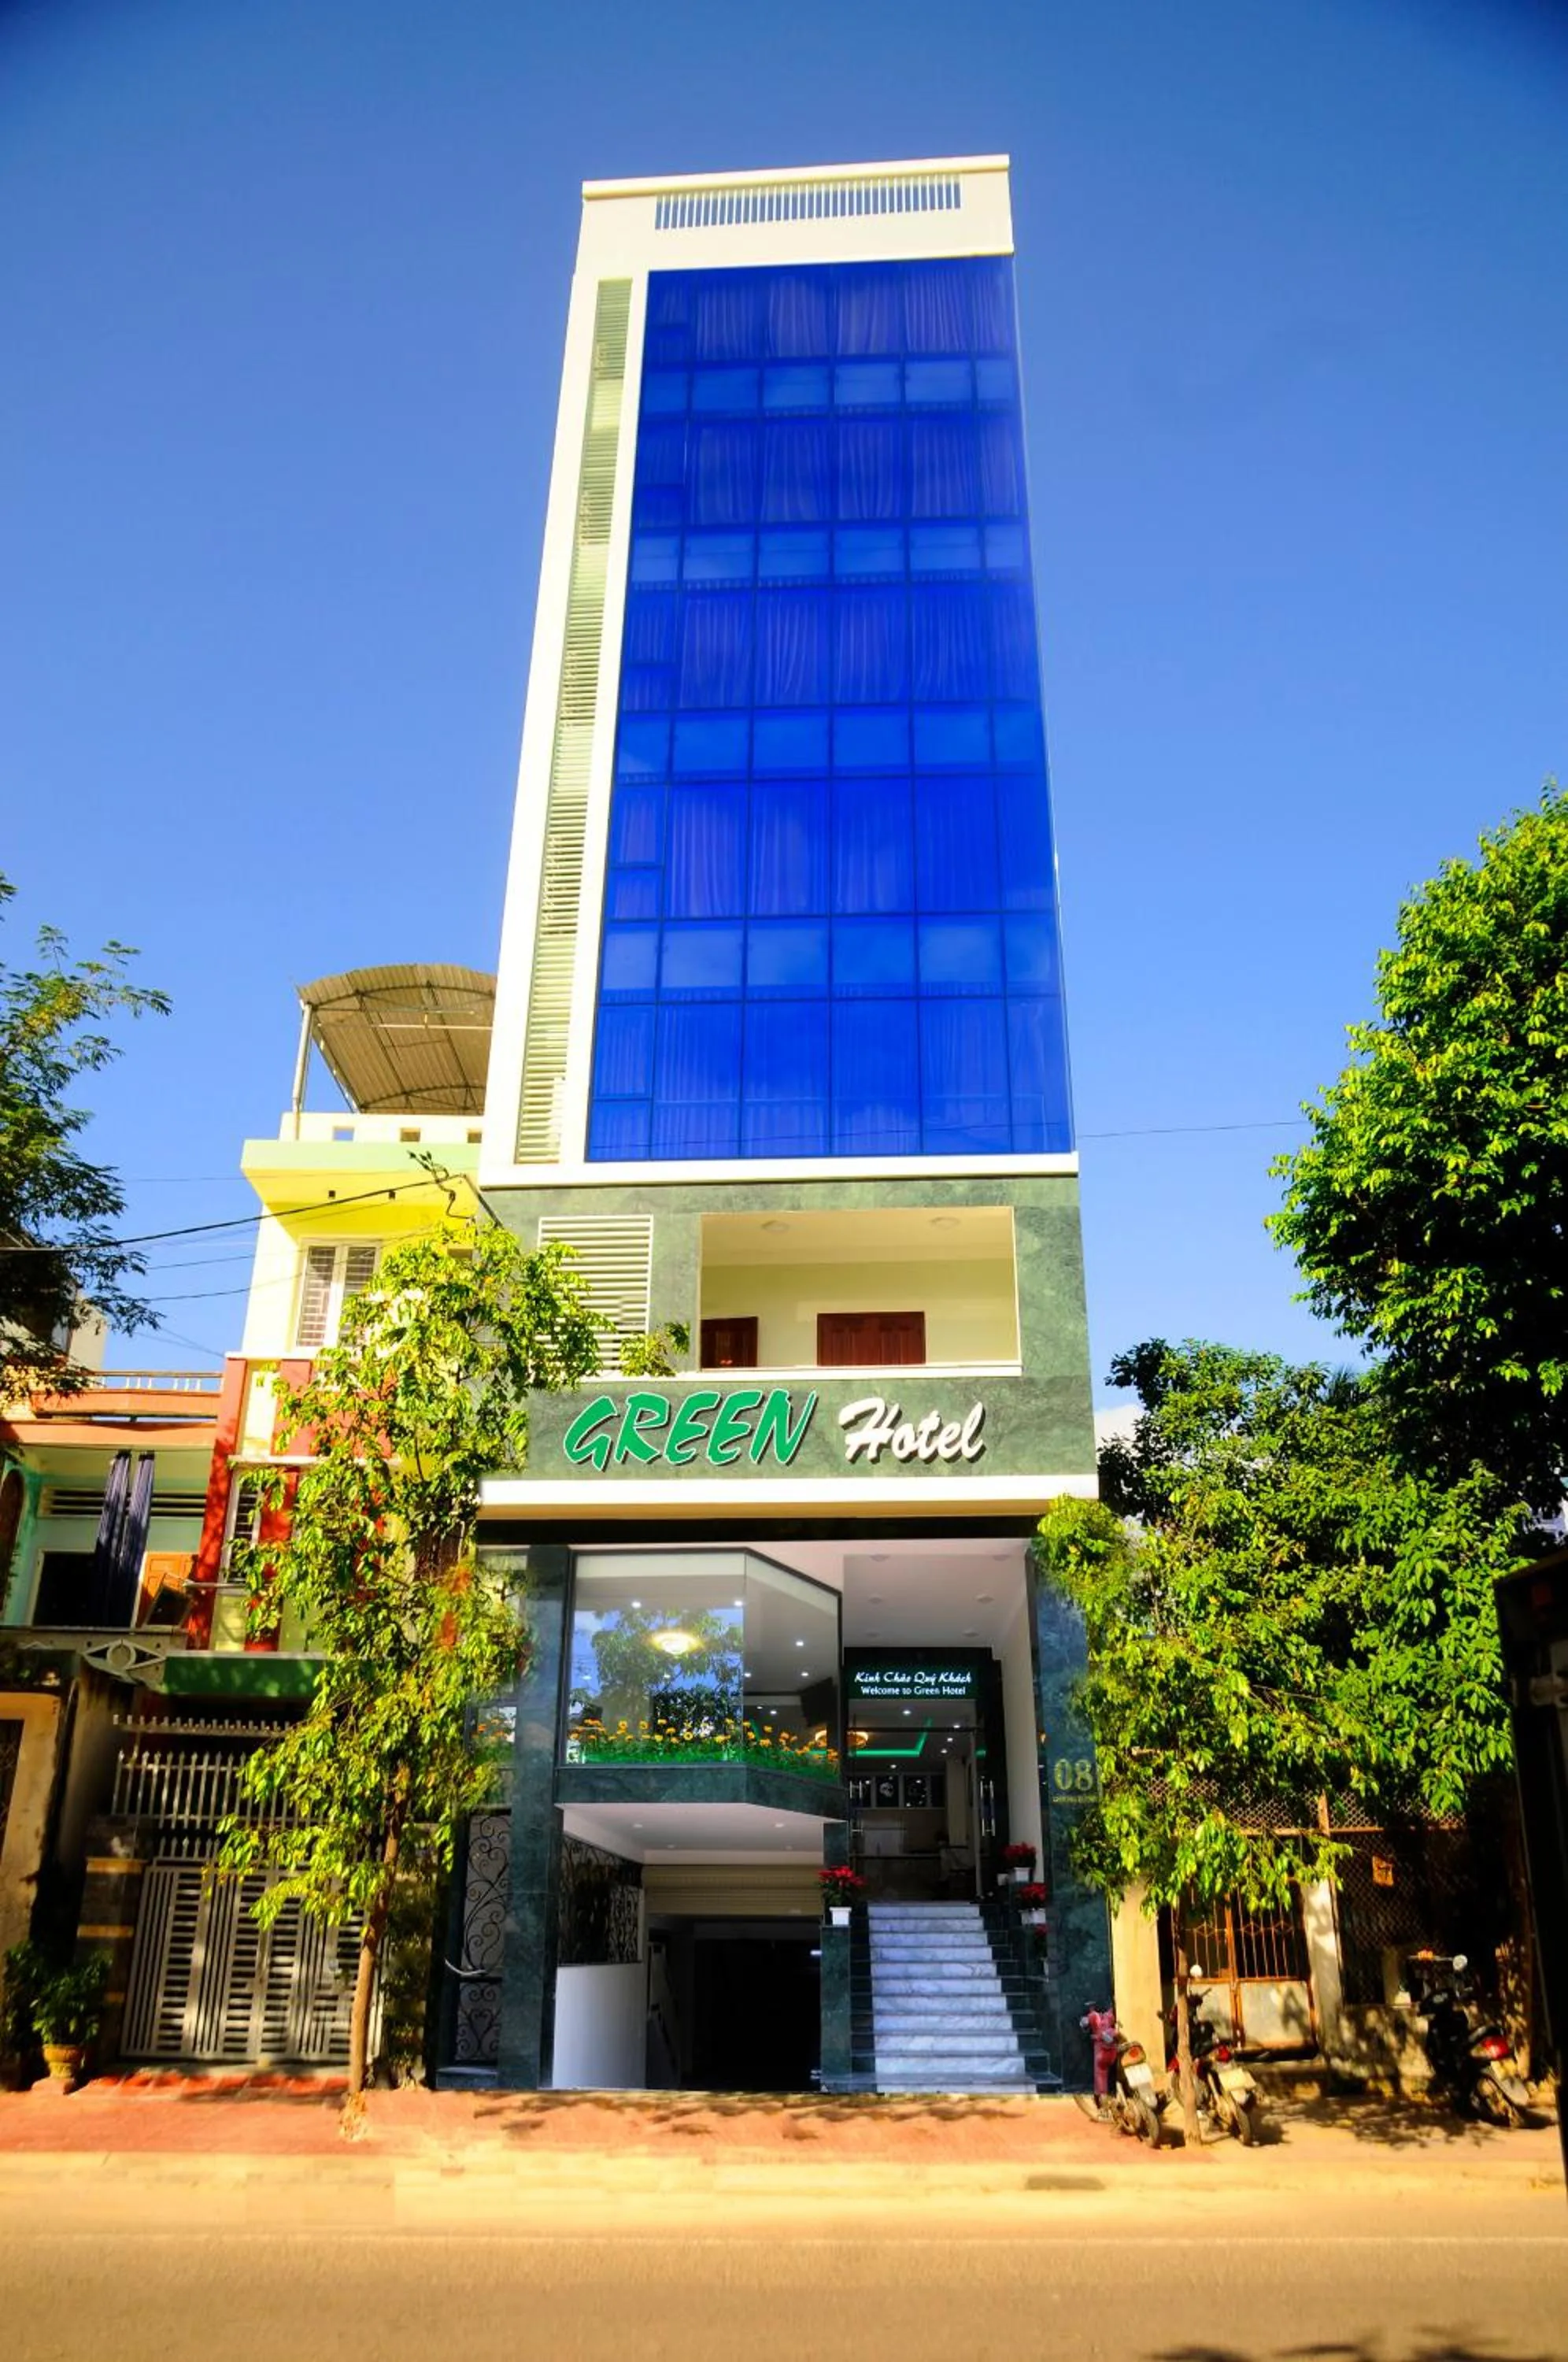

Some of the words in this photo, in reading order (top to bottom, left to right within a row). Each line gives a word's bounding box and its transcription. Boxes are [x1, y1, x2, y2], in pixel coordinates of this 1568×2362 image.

[564, 1389, 817, 1471] GREEN
[838, 1397, 985, 1462] Hotel
[860, 1686, 900, 1695] Welcome
[914, 1686, 940, 1695] Green
[942, 1686, 966, 1695] Hotel
[1054, 1758, 1093, 1791] 08
